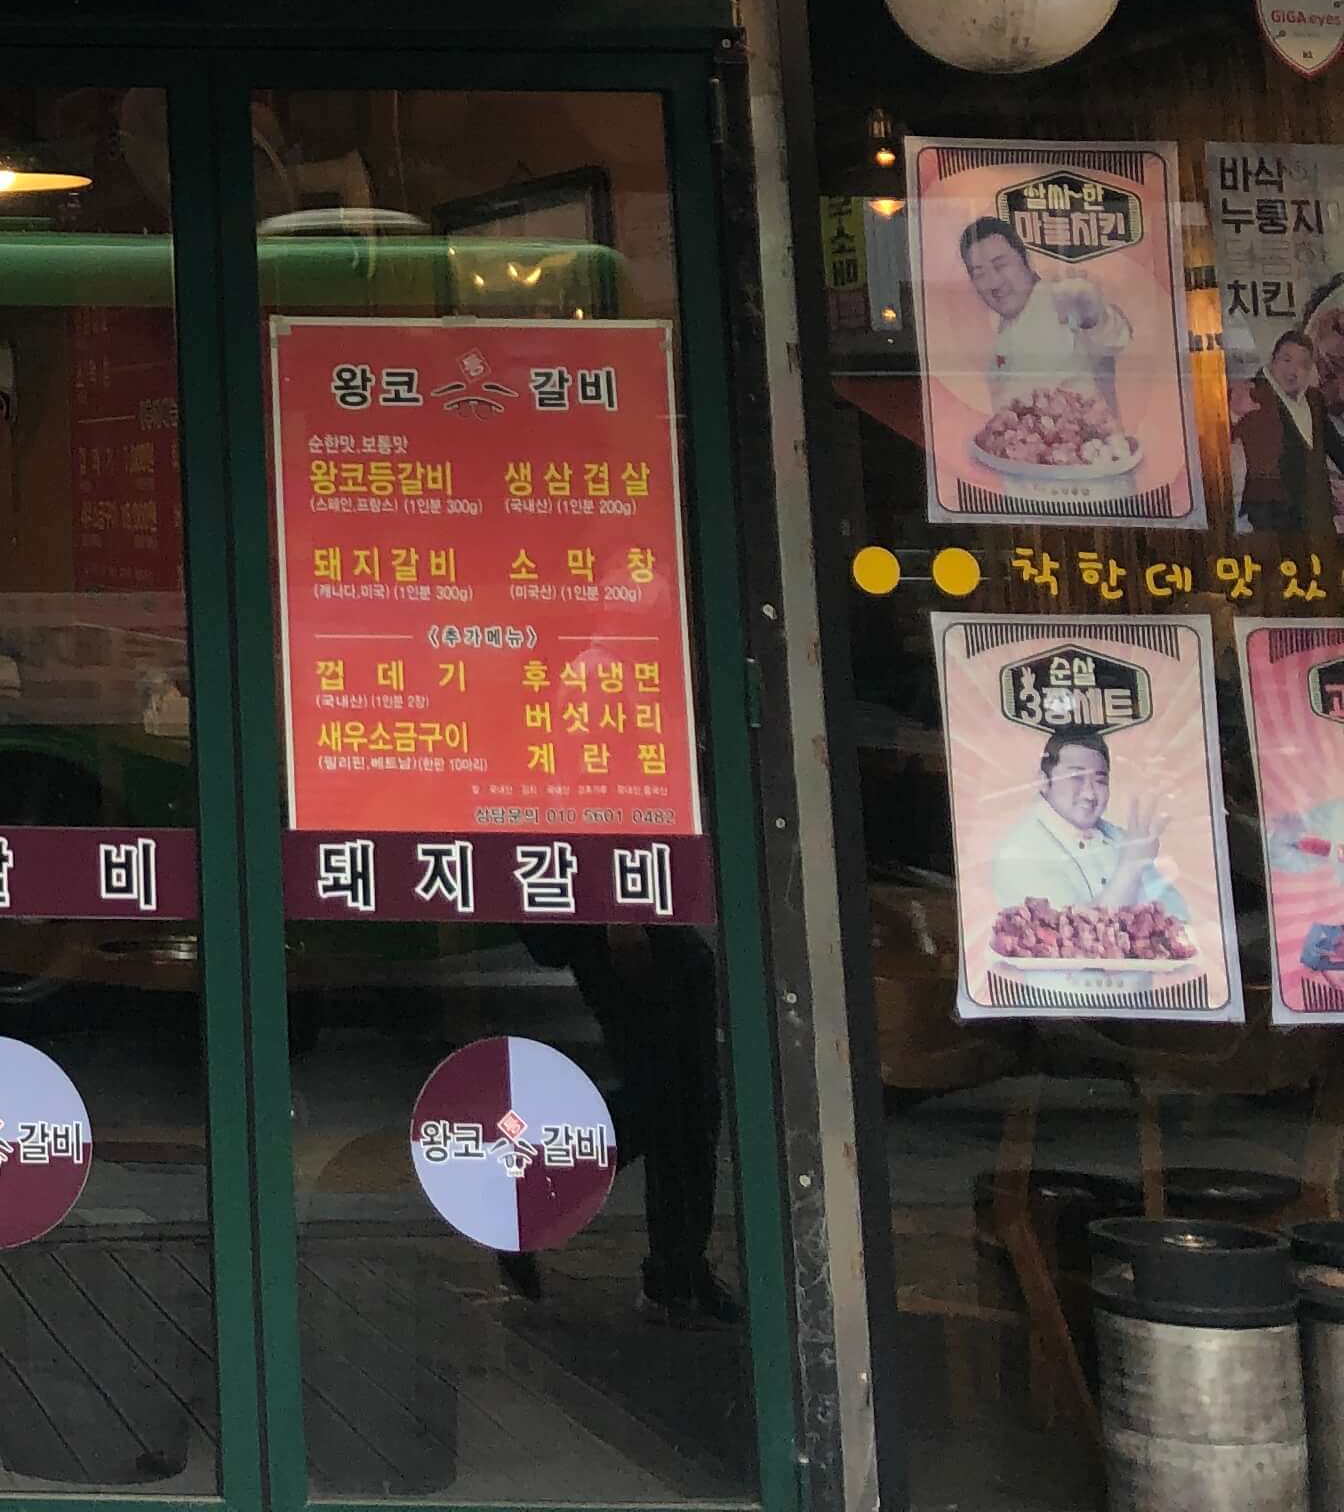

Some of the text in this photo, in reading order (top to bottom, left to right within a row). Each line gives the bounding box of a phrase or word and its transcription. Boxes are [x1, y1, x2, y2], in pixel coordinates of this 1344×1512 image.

[1227, 280, 1296, 317] 치킨
[331, 364, 424, 409] 왕코
[529, 367, 619, 411] 갈비
[310, 458, 651, 497] 왕코등갈비 생삼겹살
[313, 546, 457, 583] 돼지갈비
[522, 660, 661, 694] 후식냉면
[1050, 656, 1096, 686] 순살
[526, 701, 662, 734] 버섯사리
[317, 720, 469, 754] 새우소금구이
[317, 839, 674, 916] 돼지갈비
[18, 1120, 84, 1165] 갈비
[420, 1119, 487, 1164] 왕코
[543, 1123, 609, 1168] 갈비
